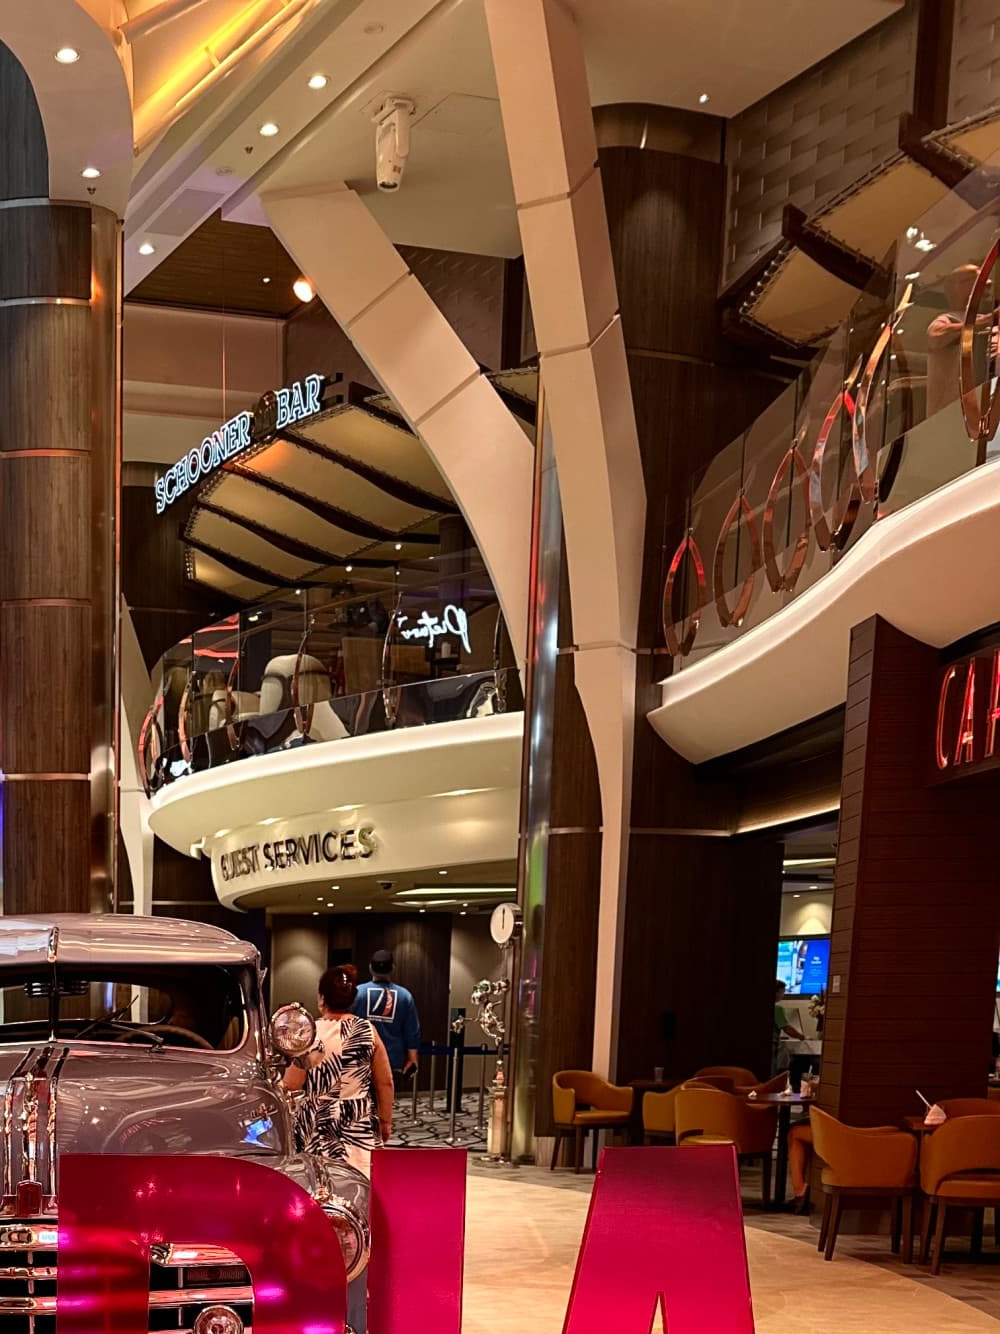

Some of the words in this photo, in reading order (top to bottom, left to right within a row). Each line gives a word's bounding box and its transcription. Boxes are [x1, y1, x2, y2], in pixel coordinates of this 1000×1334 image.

[155, 411, 252, 514] SCHOONER
[275, 374, 321, 429] BAR
[220, 844, 260, 881] GUEST
[263, 826, 377, 871] SERVICES
